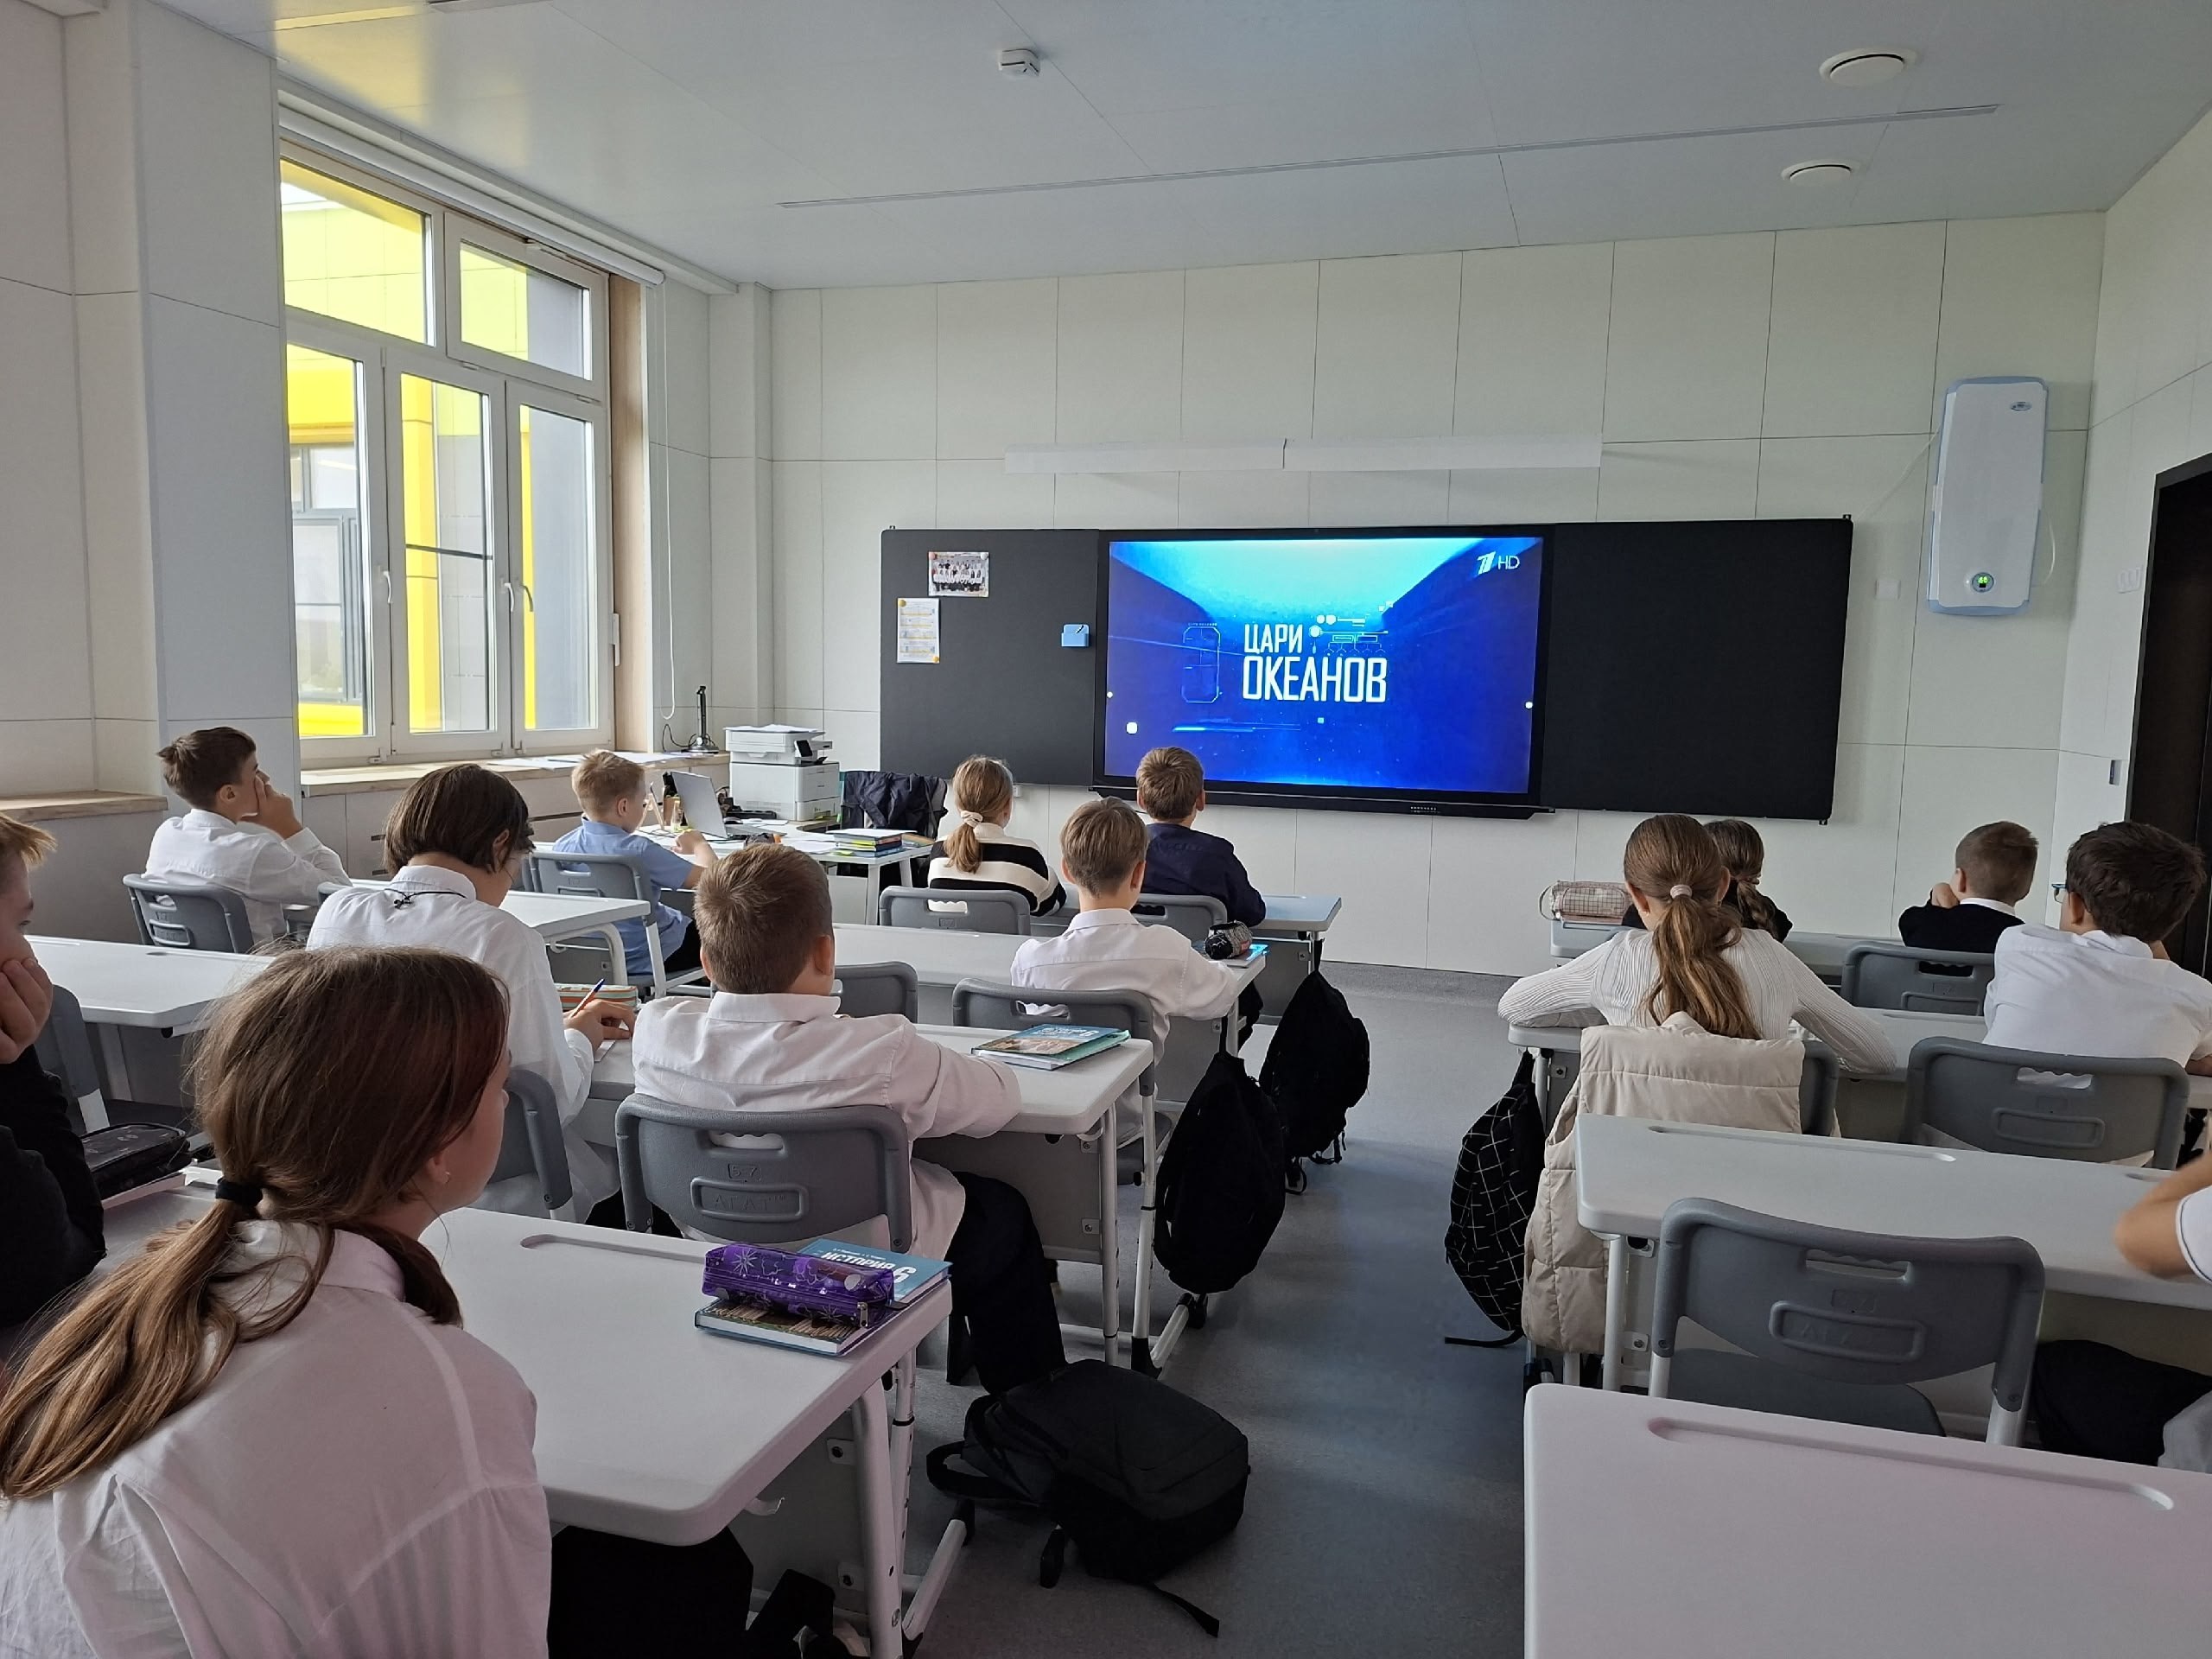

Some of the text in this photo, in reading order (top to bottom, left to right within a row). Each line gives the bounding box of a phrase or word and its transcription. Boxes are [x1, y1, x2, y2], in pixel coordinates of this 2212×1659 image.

[1497, 556, 1520, 569] HD
[1244, 624, 1303, 654] ЦАРИ
[1243, 656, 1388, 702] ОКЕАНОВ
[893, 1266, 917, 1283] 6
